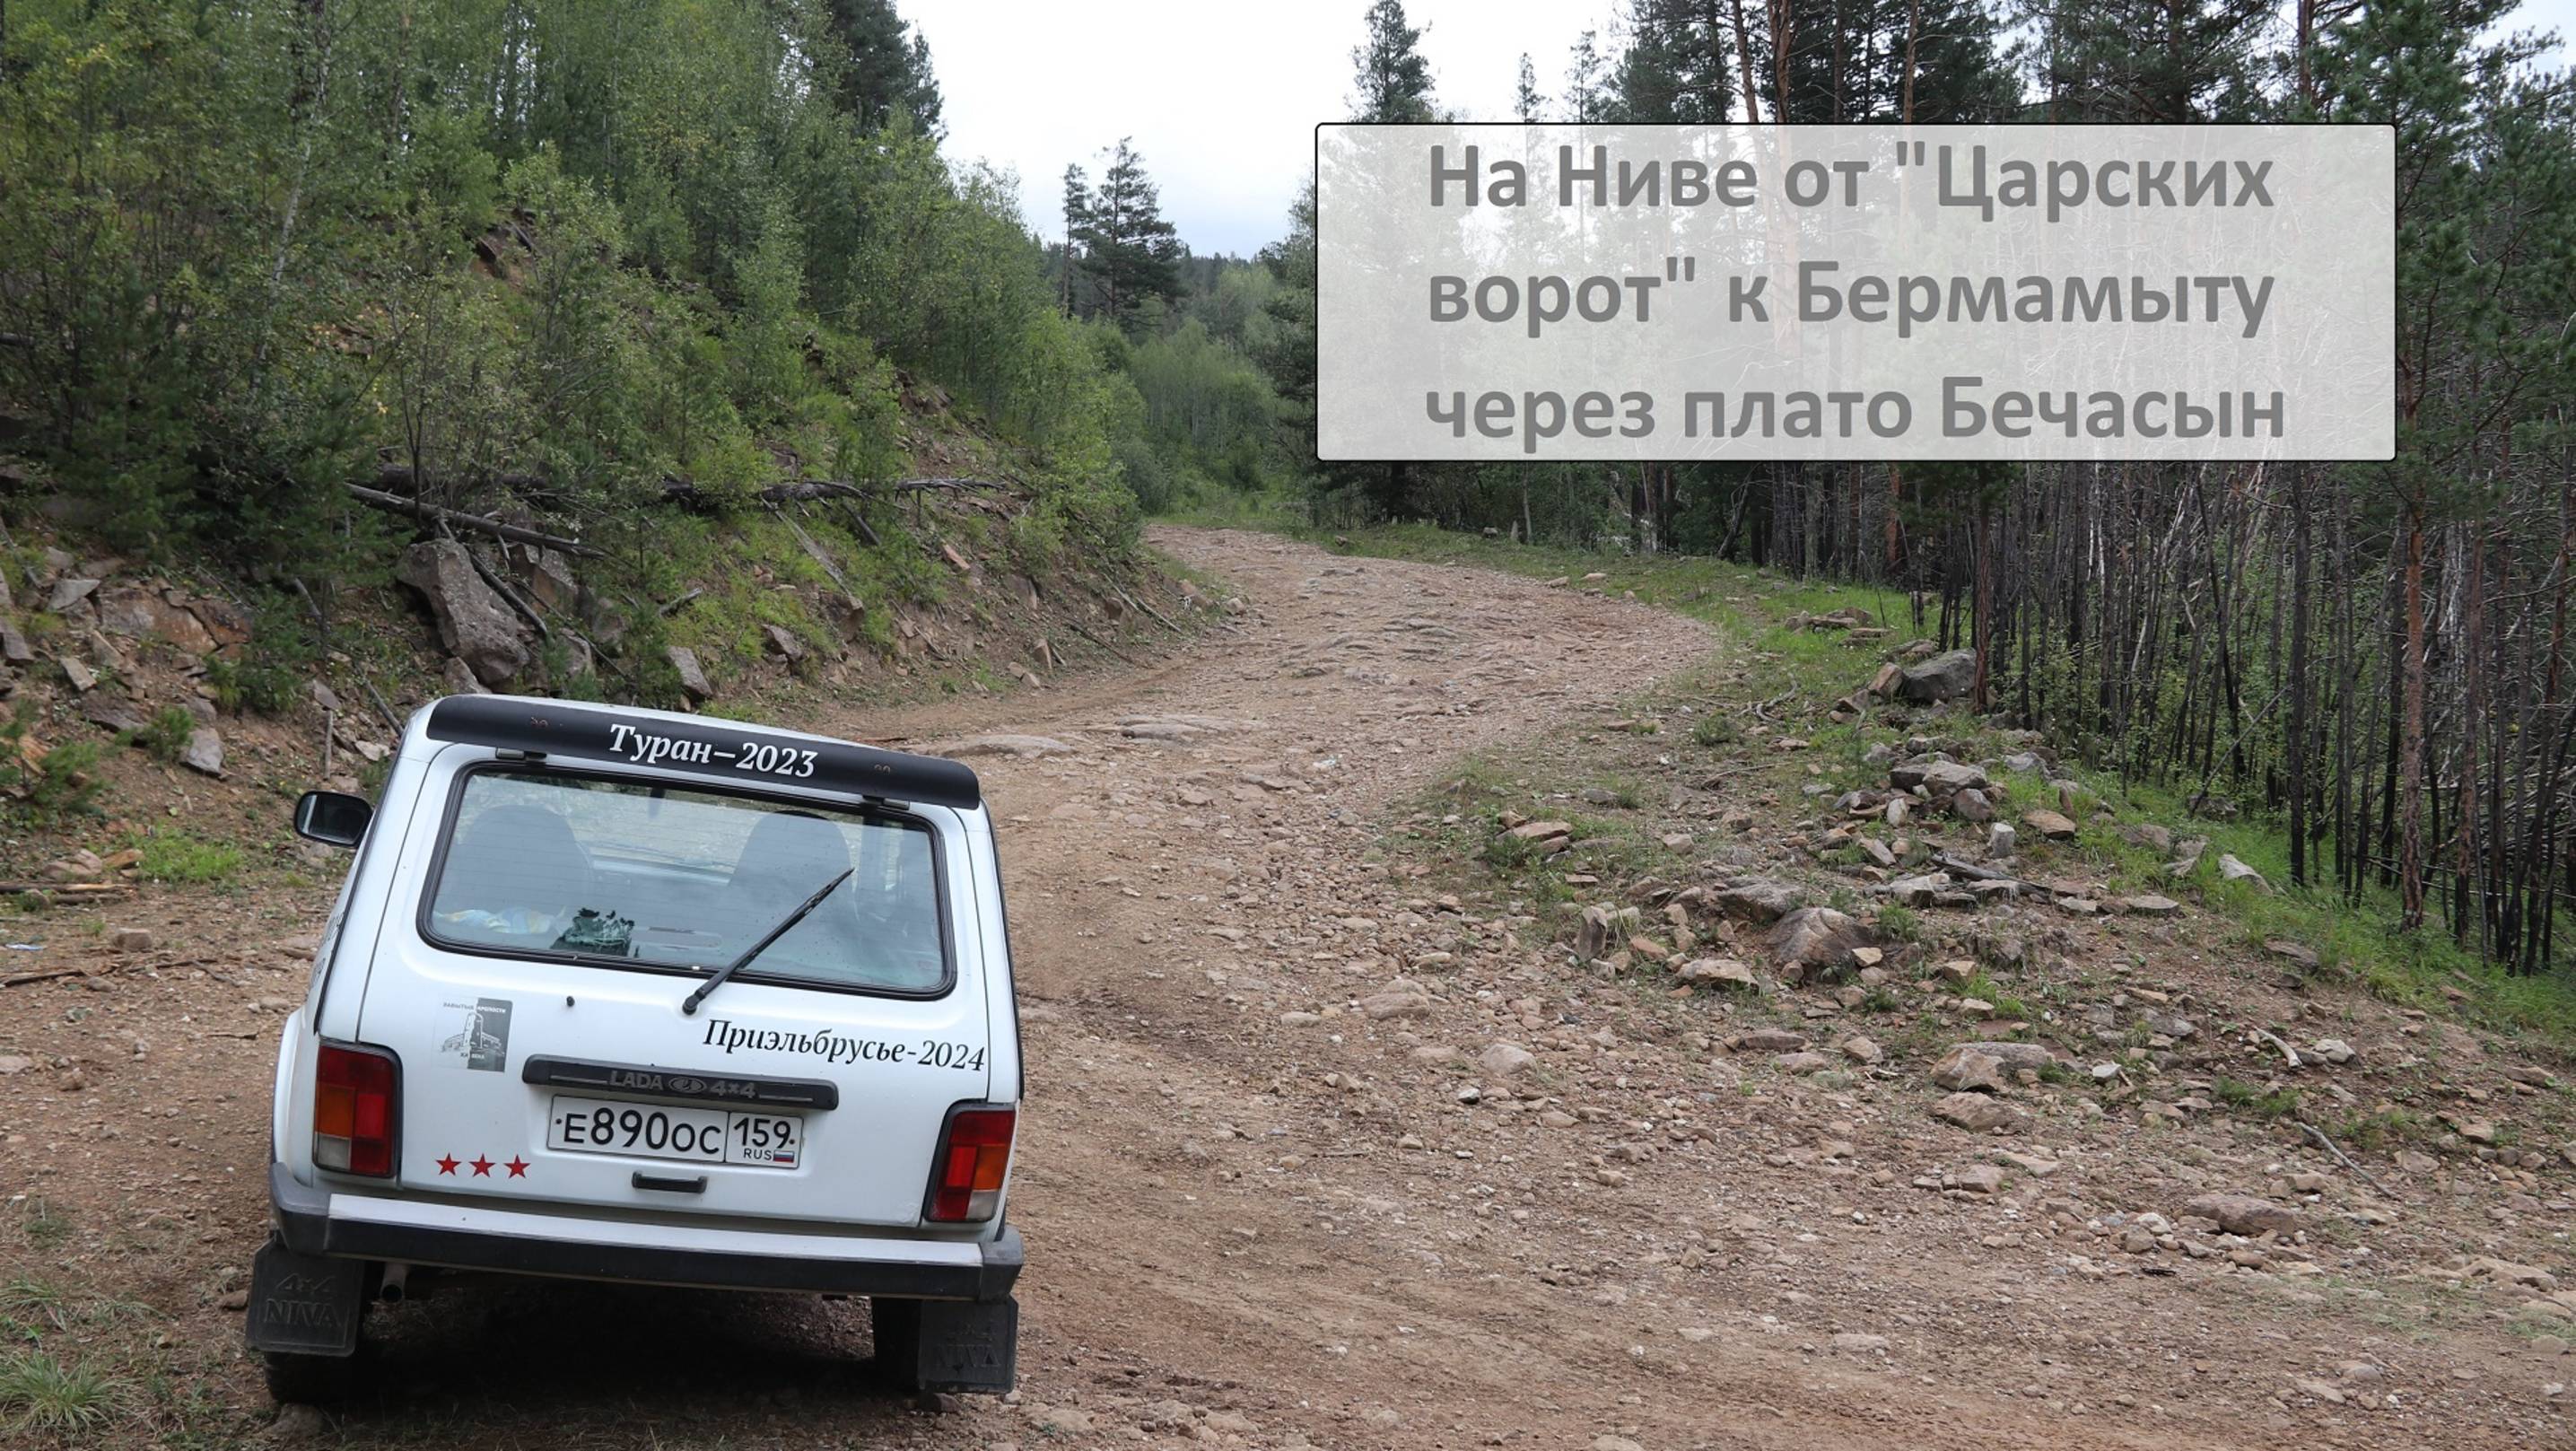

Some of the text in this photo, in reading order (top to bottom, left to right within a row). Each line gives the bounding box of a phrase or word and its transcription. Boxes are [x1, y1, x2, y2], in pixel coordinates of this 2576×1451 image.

[703, 1018, 985, 1072] Приэльбрусье-2024
[609, 1070, 665, 1091] LADA
[733, 1116, 791, 1149] 159
[743, 1147, 773, 1161] RUS
[264, 1298, 343, 1327] NIVA
